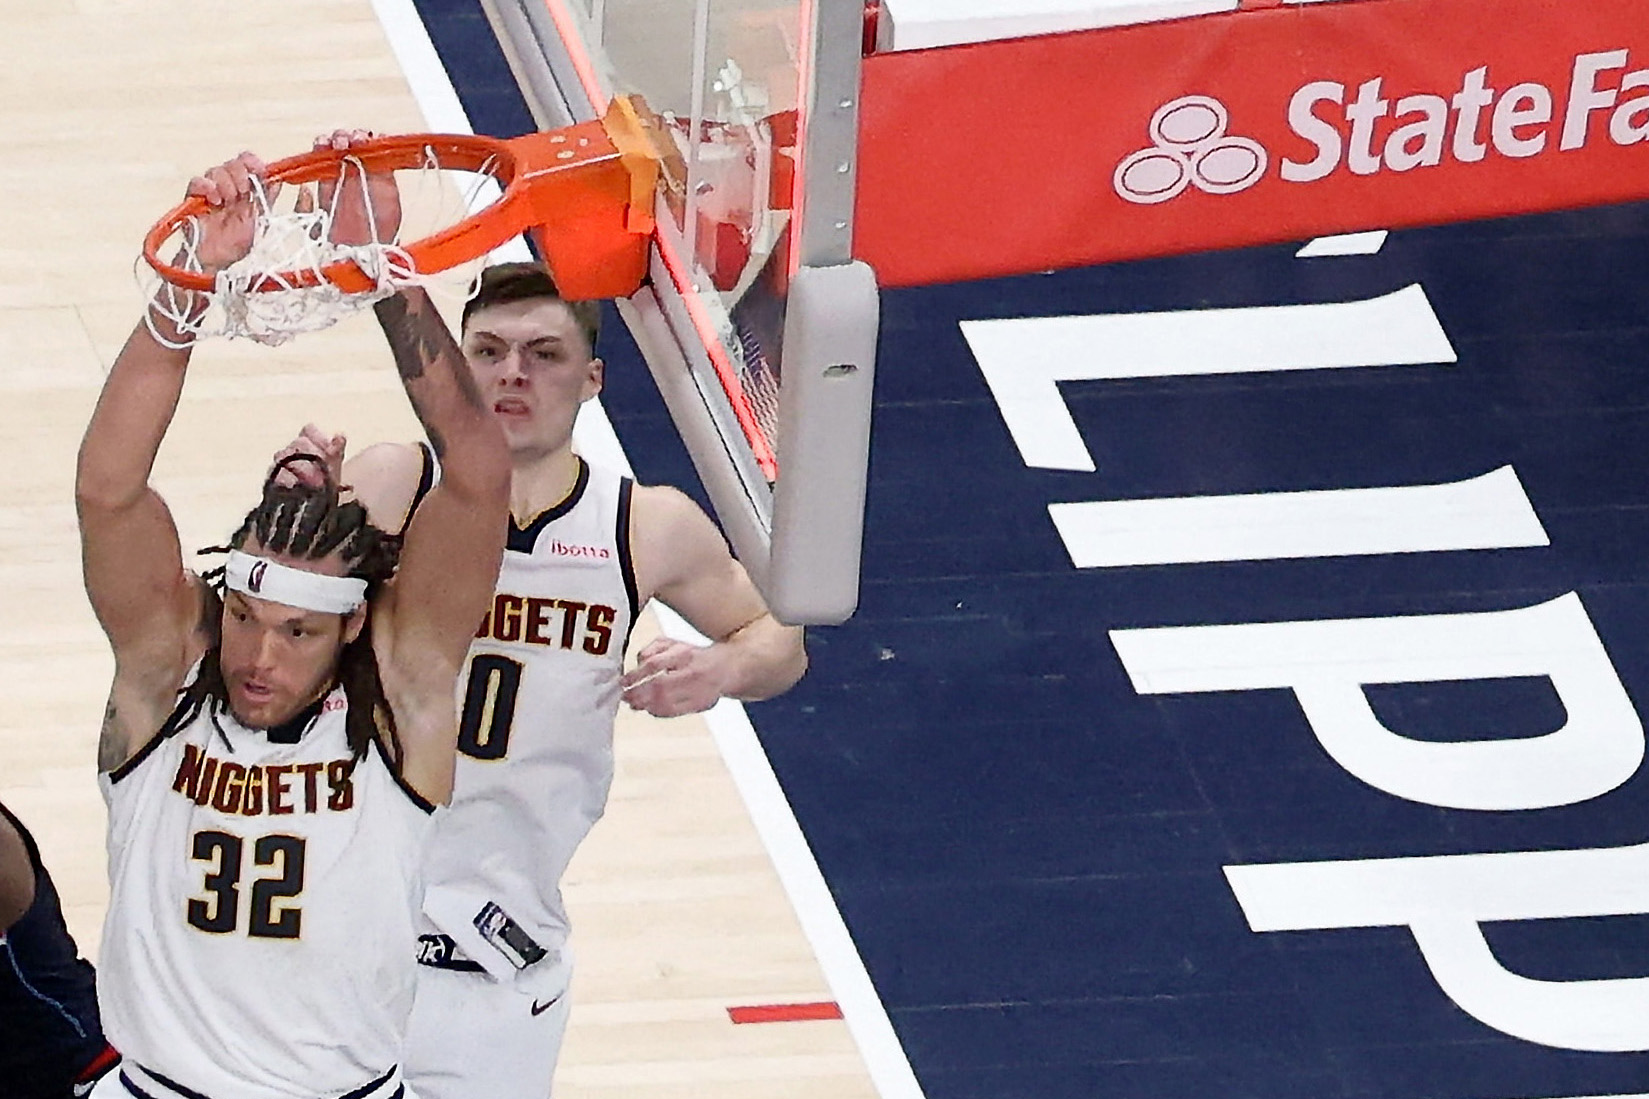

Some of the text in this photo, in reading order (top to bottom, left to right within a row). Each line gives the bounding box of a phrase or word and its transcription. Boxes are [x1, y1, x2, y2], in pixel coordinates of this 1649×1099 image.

[1279, 64, 1553, 183] State
[550, 538, 611, 559] ibotta
[456, 653, 525, 760] 0
[186, 829, 308, 940] 32
